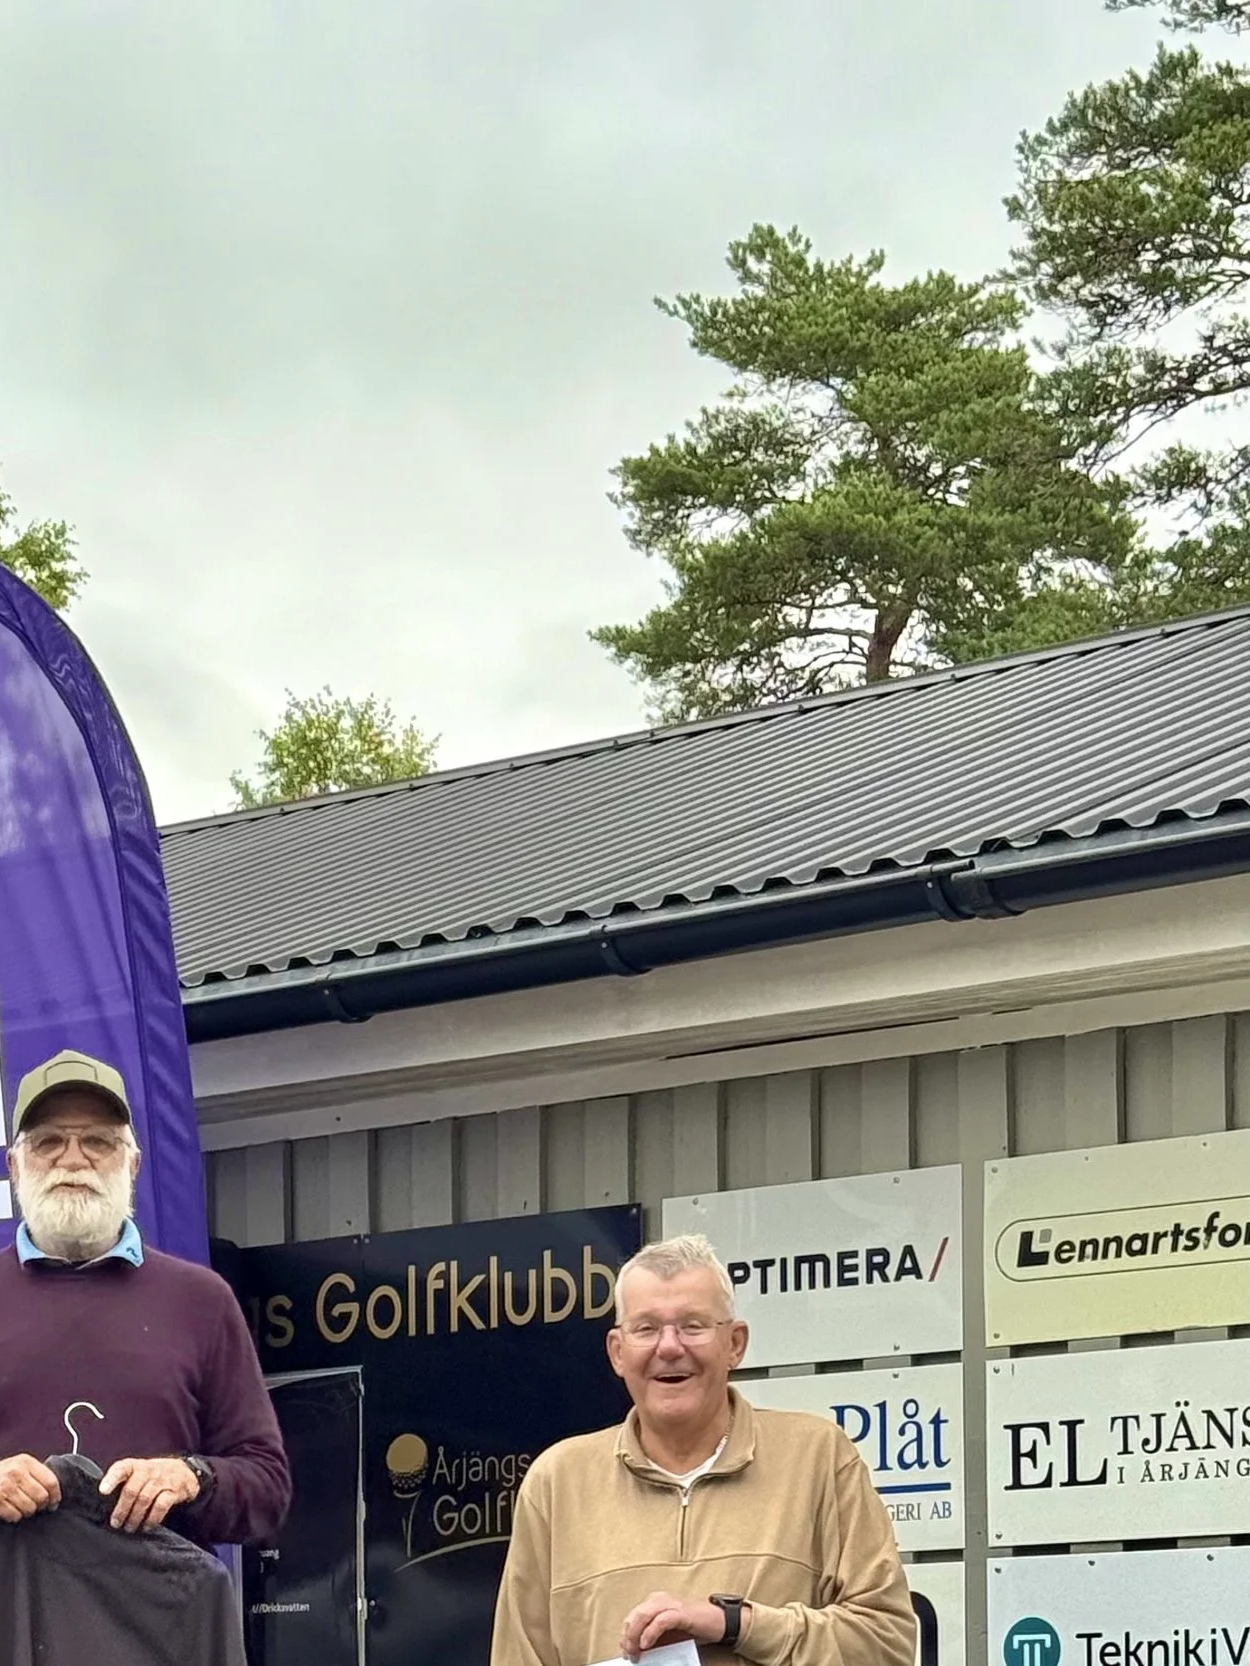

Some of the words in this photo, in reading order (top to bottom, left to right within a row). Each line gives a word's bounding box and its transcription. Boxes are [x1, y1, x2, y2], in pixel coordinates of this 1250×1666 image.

[315, 1244, 617, 1344] Golfklubb
[829, 1399, 951, 1471] Plåt
[1003, 1418, 1108, 1491] EL
[432, 1446, 530, 1490] Årjängs
[1116, 1466, 1126, 1484] I
[1140, 1457, 1250, 1484] ÅRJÄNG
[433, 1489, 515, 1536] Golf
[929, 1501, 953, 1520] AB
